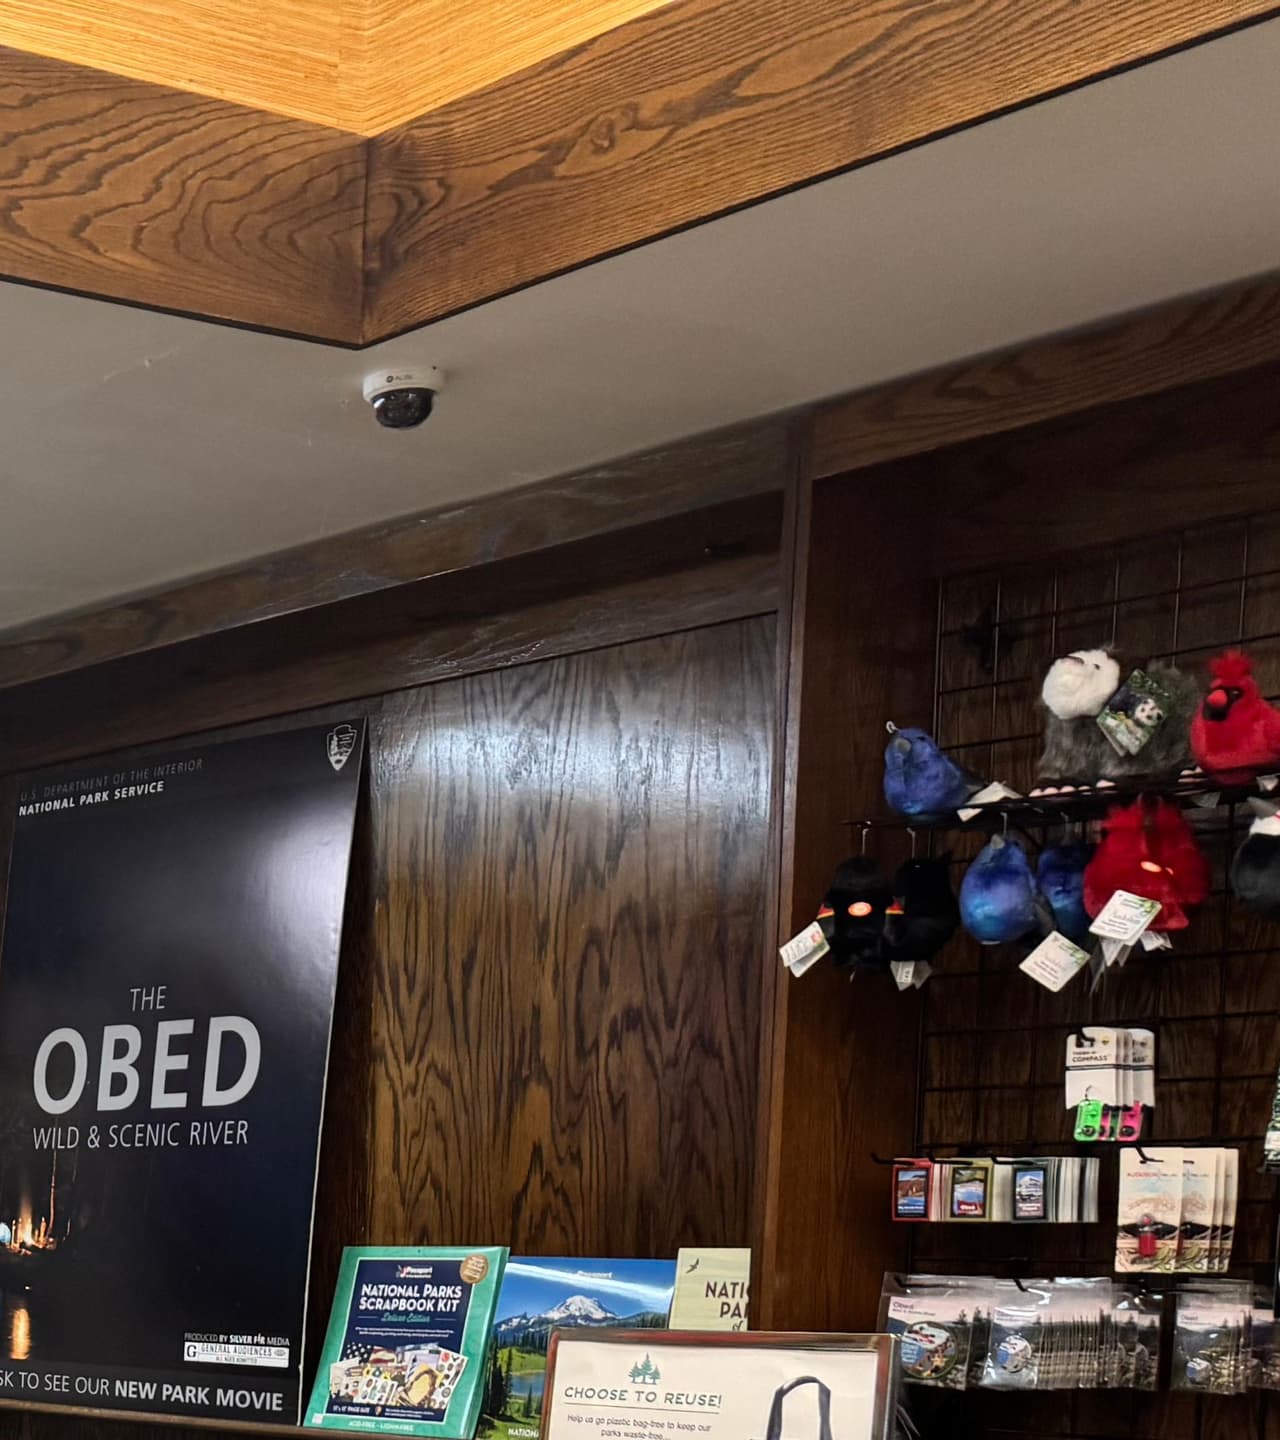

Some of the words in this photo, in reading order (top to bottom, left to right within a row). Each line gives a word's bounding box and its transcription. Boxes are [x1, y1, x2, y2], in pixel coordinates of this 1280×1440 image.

[131, 768, 149, 781] THE
[154, 758, 202, 777] INTERIOR
[19, 798, 75, 816] NATIONAL
[80, 791, 109, 805] PARK
[114, 781, 165, 800] SERVICE
[130, 985, 167, 1012] THE
[33, 1015, 261, 1115] OBED
[33, 1126, 79, 1150] WILD
[87, 1125, 101, 1148] &
[108, 1123, 181, 1147] SCENIC
[190, 1120, 249, 1145] RIVER
[362, 1284, 420, 1297] NATIONAL
[423, 1284, 462, 1298] PARKS
[359, 1297, 434, 1311] SCRAPBOOK
[437, 1299, 459, 1312] KIT
[187, 1345, 196, 1357] G
[18, 1372, 39, 1390] TO
[44, 1374, 70, 1392] SEE
[75, 1376, 109, 1395] OUR
[114, 1380, 157, 1399] NEW
[162, 1383, 209, 1405] PARK
[216, 1390, 283, 1410] MOVIE
[564, 1387, 628, 1401] CHOOSE
[635, 1391, 657, 1402] TO
[664, 1393, 722, 1407] REUSE!
[568, 1414, 583, 1423] Help
[607, 1416, 630, 1428] plastic
[634, 1419, 665, 1430] bag-free
[677, 1422, 695, 1432] keep
[601, 1429, 621, 1438] parks
